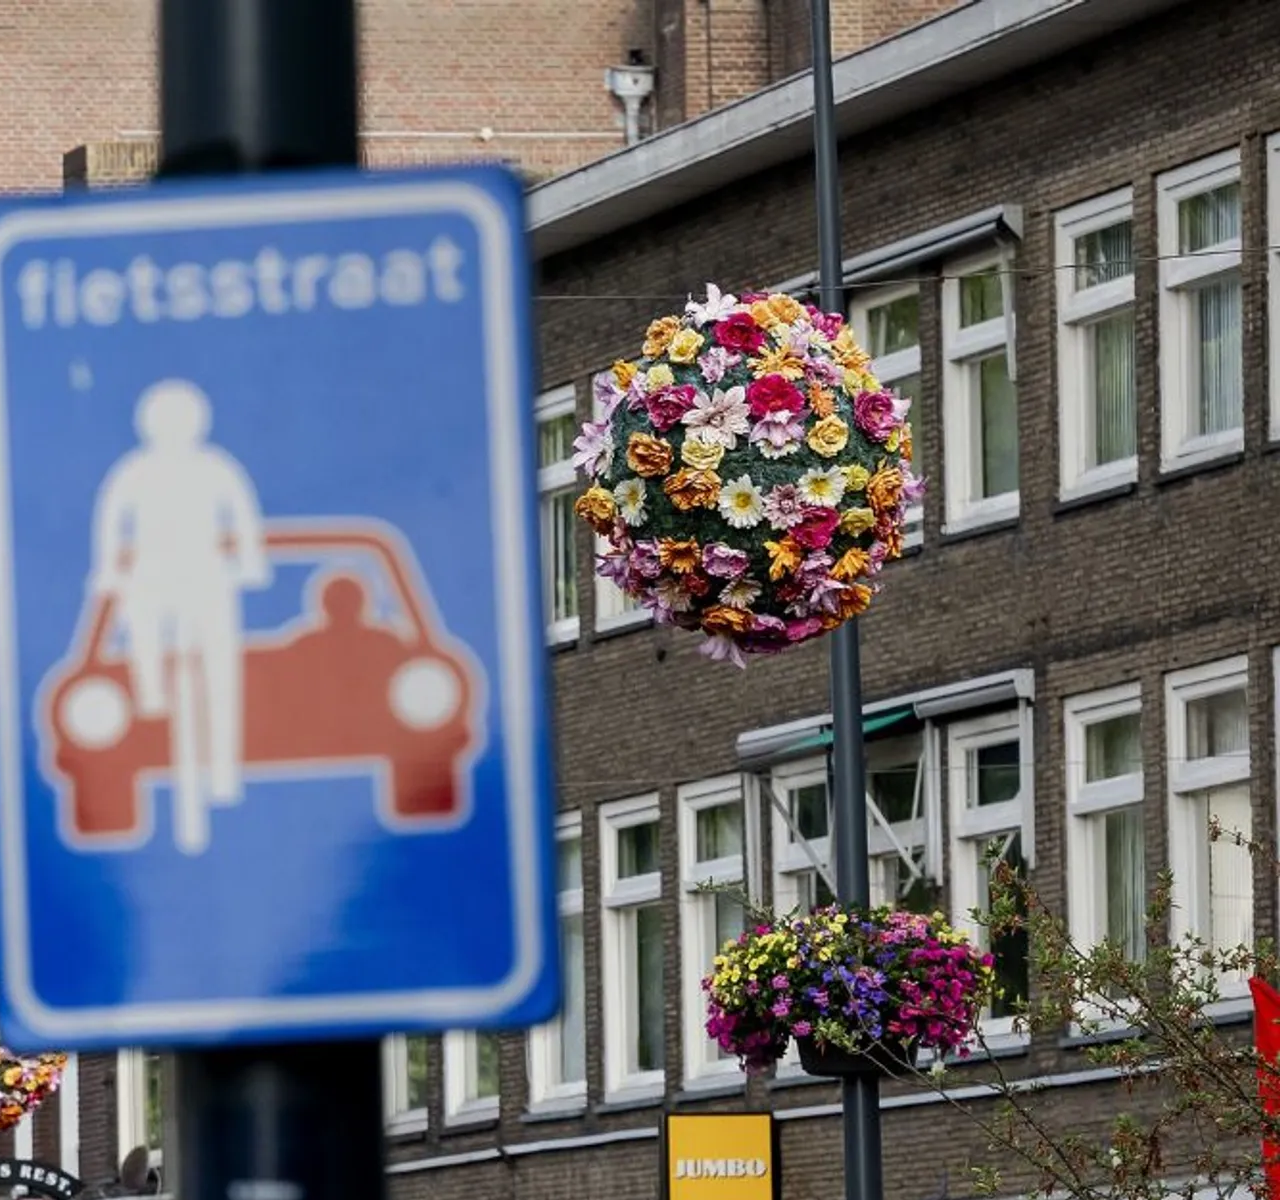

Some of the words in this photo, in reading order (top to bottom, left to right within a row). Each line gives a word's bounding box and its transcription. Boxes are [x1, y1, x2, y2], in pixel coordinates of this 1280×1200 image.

[21, 234, 464, 330] fietsstraat
[20, 1164, 72, 1196] REST.
[676, 1158, 767, 1178] JUMBO
